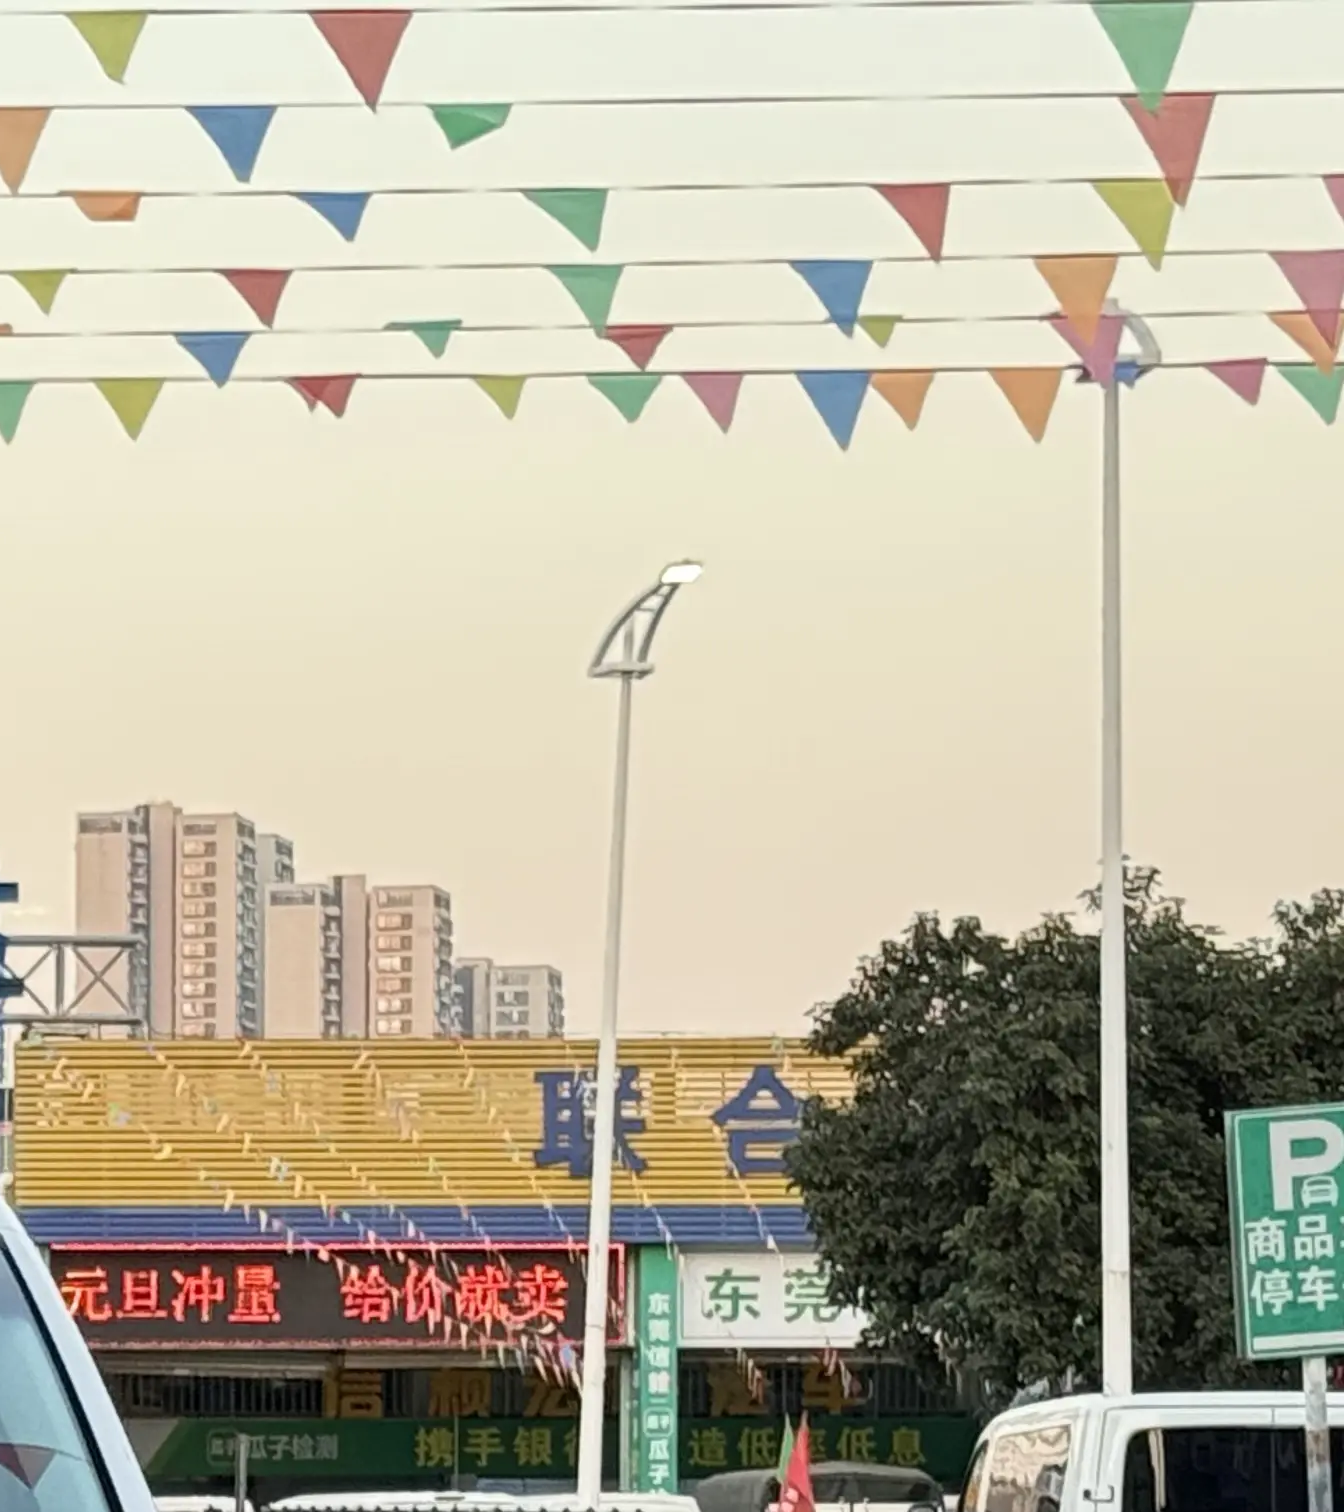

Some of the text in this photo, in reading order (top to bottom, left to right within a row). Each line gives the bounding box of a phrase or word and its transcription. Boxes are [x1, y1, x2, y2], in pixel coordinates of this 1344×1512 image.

[1269, 1119, 1344, 1211] P
[1245, 1214, 1344, 1265] 商品
[61, 1265, 280, 1322] 元旦冲量
[1250, 1265, 1344, 1316] 停车
